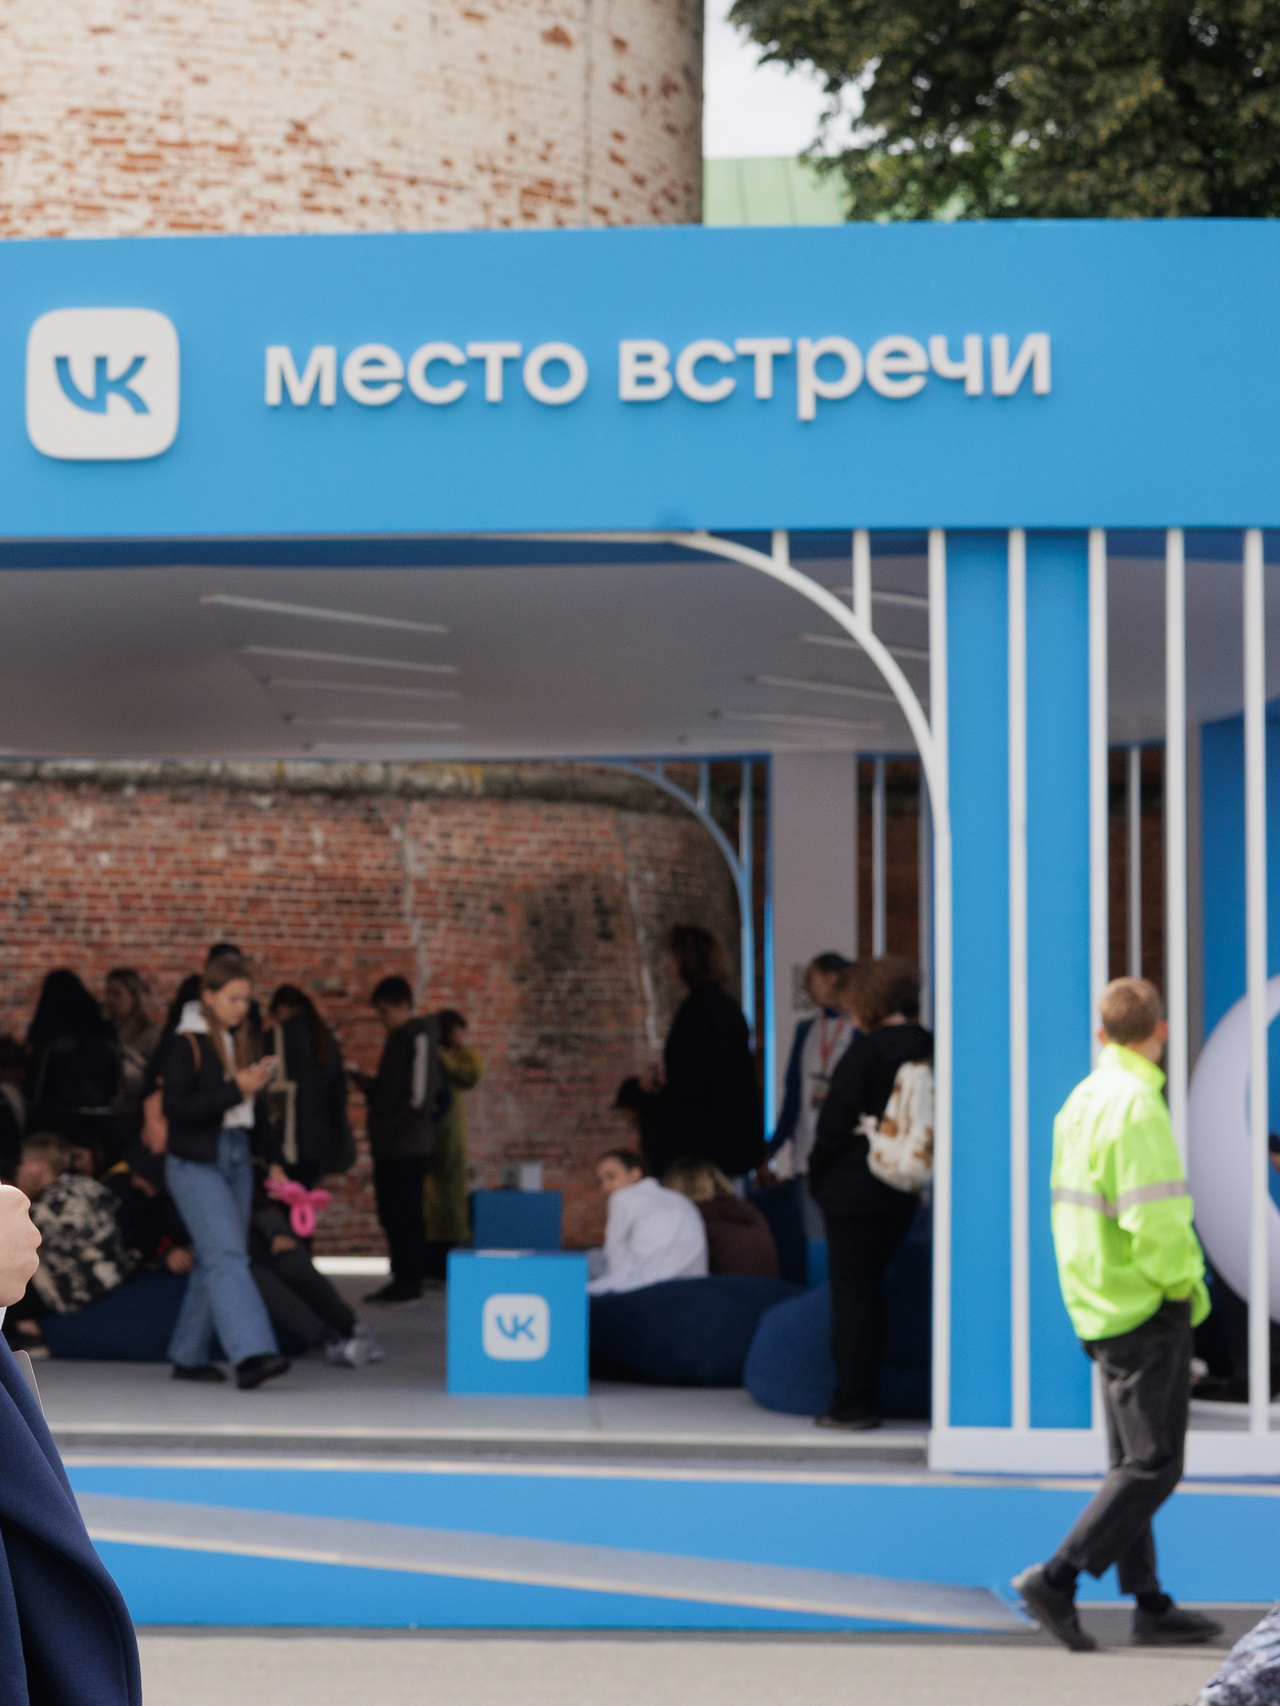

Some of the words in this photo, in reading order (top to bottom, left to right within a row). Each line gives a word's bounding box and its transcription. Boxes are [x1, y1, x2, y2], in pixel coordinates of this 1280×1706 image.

[55, 356, 151, 415] VK
[265, 341, 588, 405] место
[619, 332, 1052, 421] встречи
[496, 1313, 536, 1342] VK
